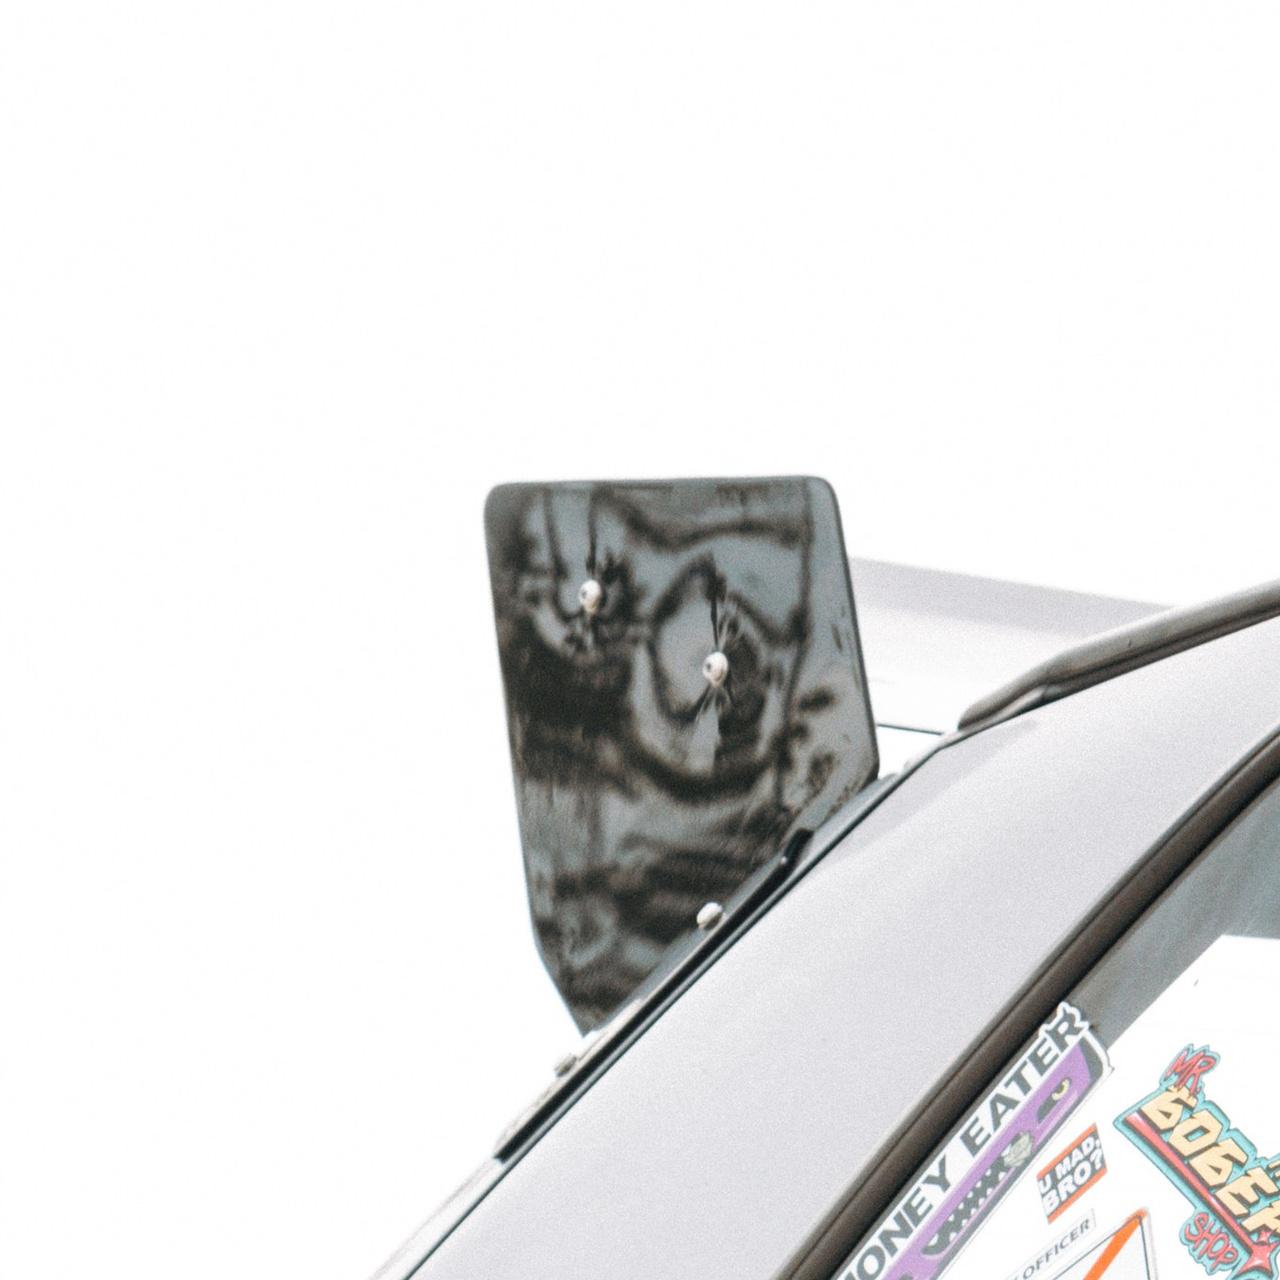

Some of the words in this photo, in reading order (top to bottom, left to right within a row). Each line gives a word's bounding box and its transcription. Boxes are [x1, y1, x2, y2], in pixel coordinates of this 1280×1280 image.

[958, 1008, 1086, 1158] EATER
[1038, 1173, 1052, 1195] U
[1042, 1148, 1103, 1217] BRO?
[1022, 1218, 1091, 1280] OFFICER
[1185, 1212, 1239, 1272] SHOP
